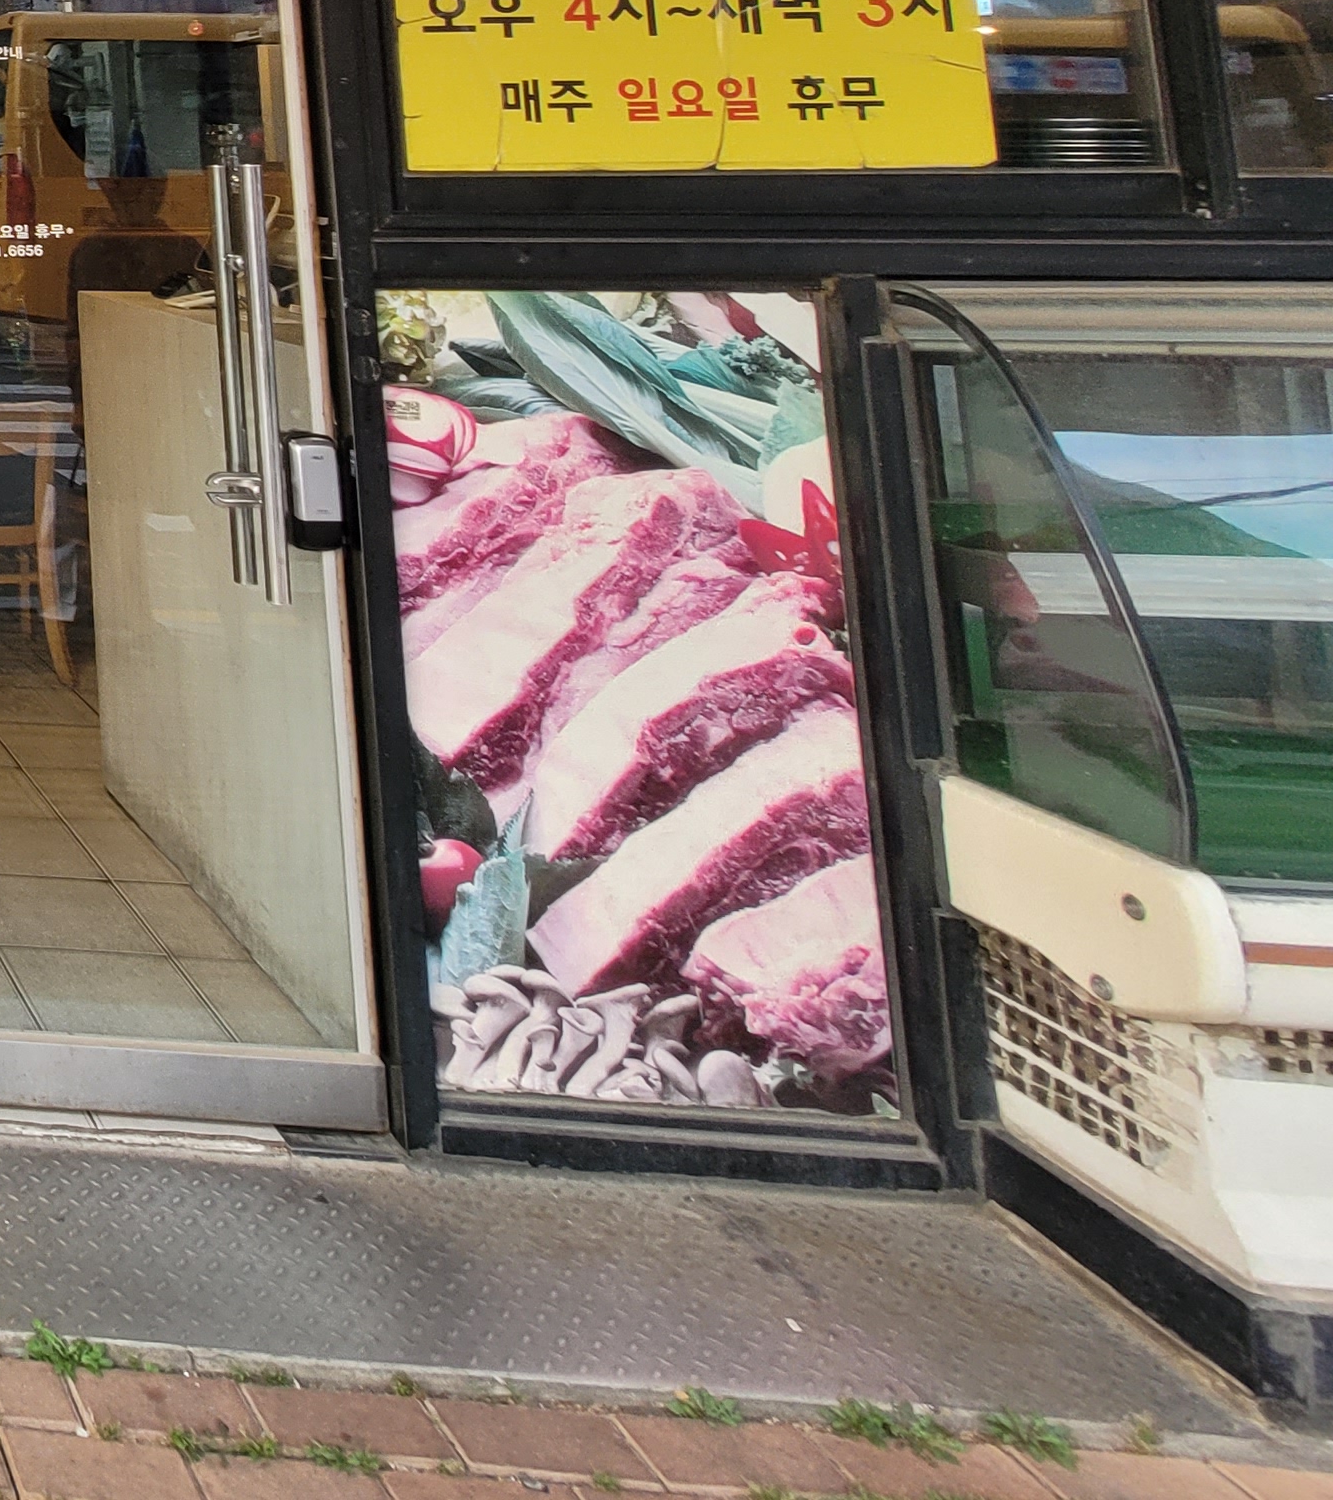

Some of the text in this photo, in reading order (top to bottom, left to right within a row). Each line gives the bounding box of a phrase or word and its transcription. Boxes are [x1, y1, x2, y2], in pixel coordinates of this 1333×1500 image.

[500, 74, 885, 123] 매주 일요일 휴무
[34, 223, 66, 239] 휴무
